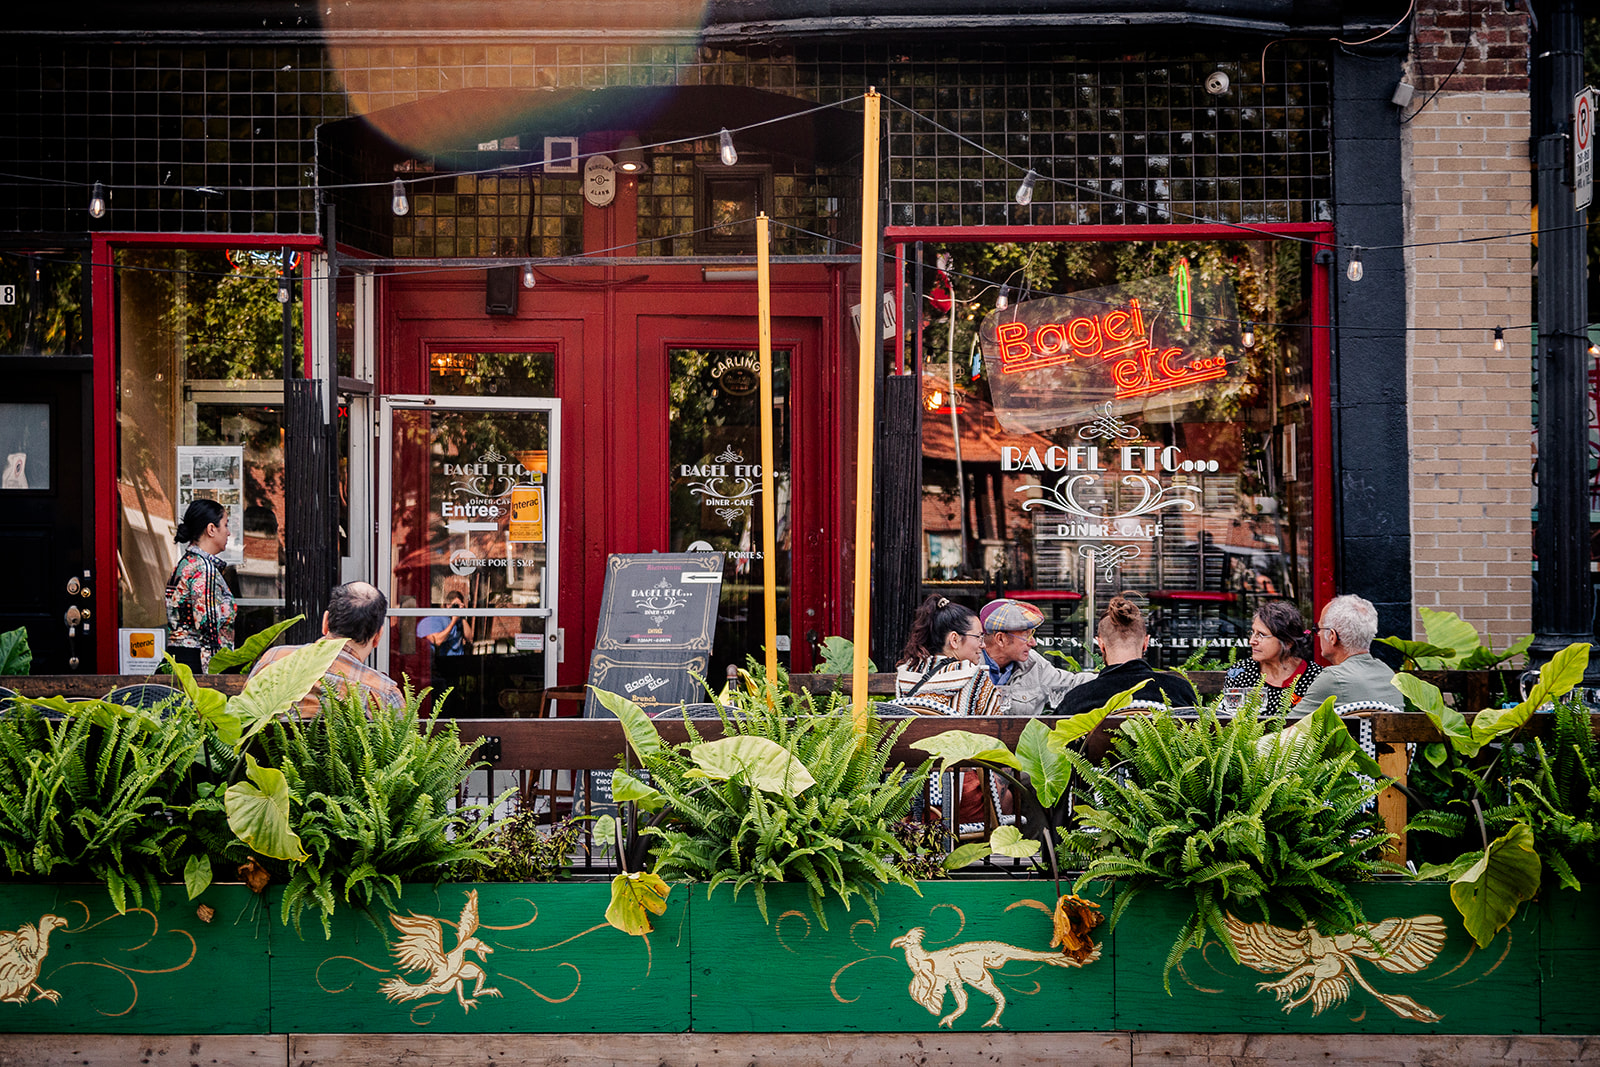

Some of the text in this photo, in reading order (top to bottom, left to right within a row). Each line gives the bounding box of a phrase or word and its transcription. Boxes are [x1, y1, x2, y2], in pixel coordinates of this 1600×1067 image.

[996, 298, 1146, 364] Bagel
[711, 356, 761, 378] CARLING
[1001, 445, 1219, 472] BAGEL ETC...
[443, 463, 492, 476] BAGEL
[680, 464, 779, 478] BAGEL ETC.
[1121, 520, 1164, 537] CAFÉ
[454, 558, 486, 567] L'AUTRE
[631, 589, 662, 597] BAGEL
[130, 639, 154, 649] Interac
[1170, 638, 1189, 647] LE
[632, 694, 657, 702] Brunch
